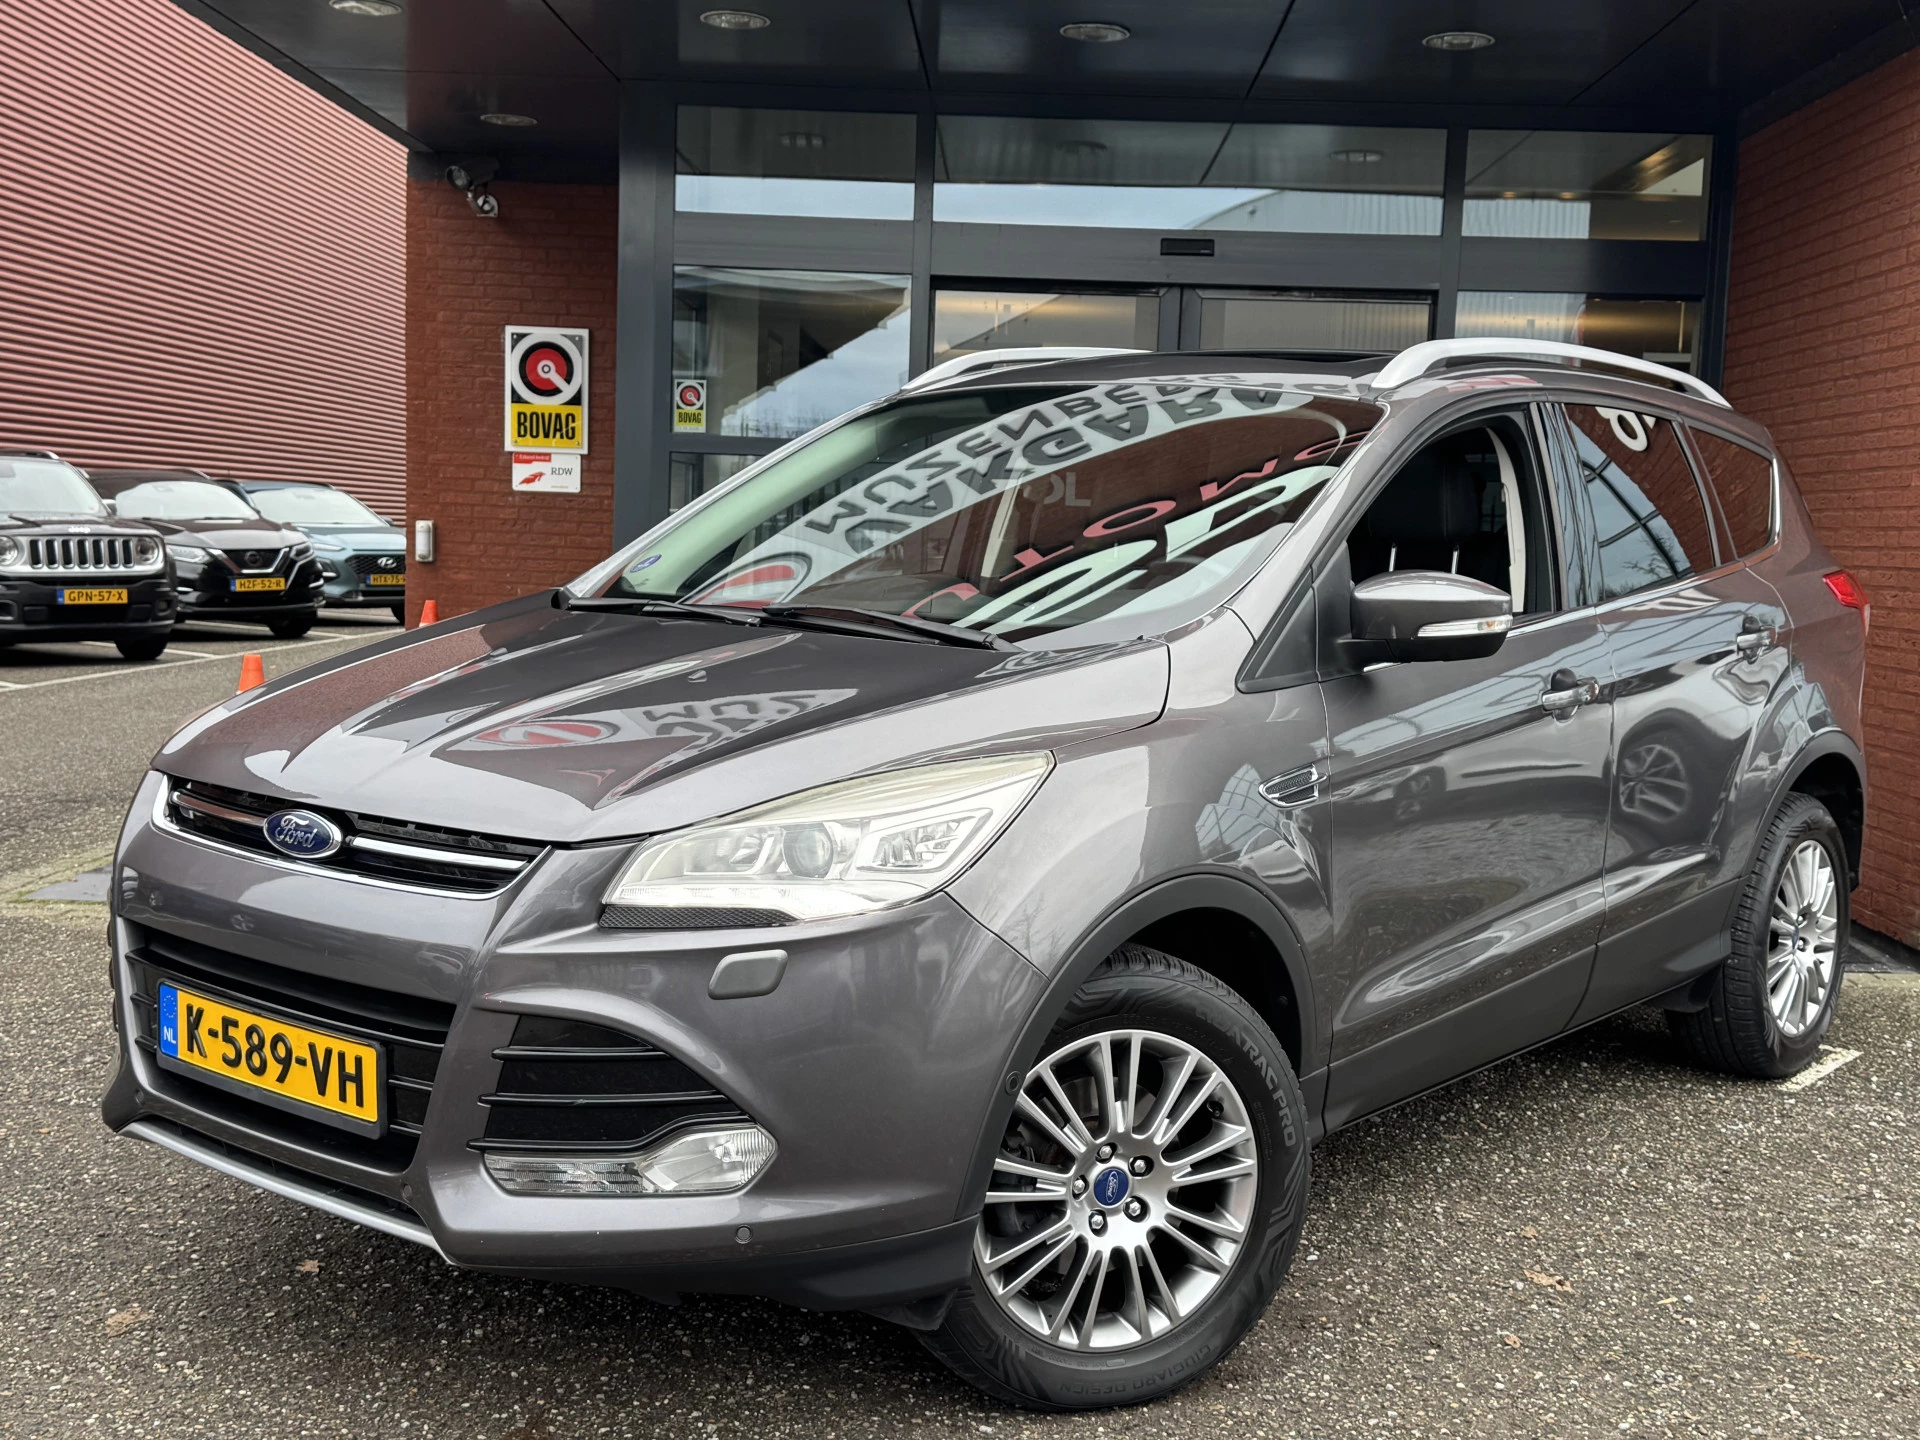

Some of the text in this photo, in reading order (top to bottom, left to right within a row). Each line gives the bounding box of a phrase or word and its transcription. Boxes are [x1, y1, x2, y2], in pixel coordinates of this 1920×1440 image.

[517, 411, 576, 440] BOVAG
[678, 411, 702, 424] BOVAG
[551, 467, 573, 476] RDW
[240, 579, 282, 589] HZF-52-R
[68, 590, 124, 602] GPN-57-X
[276, 814, 318, 849] Ford
[164, 1024, 177, 1045] NL
[186, 1003, 365, 1108] K-589-VH
[1272, 1087, 1297, 1147] PRO
